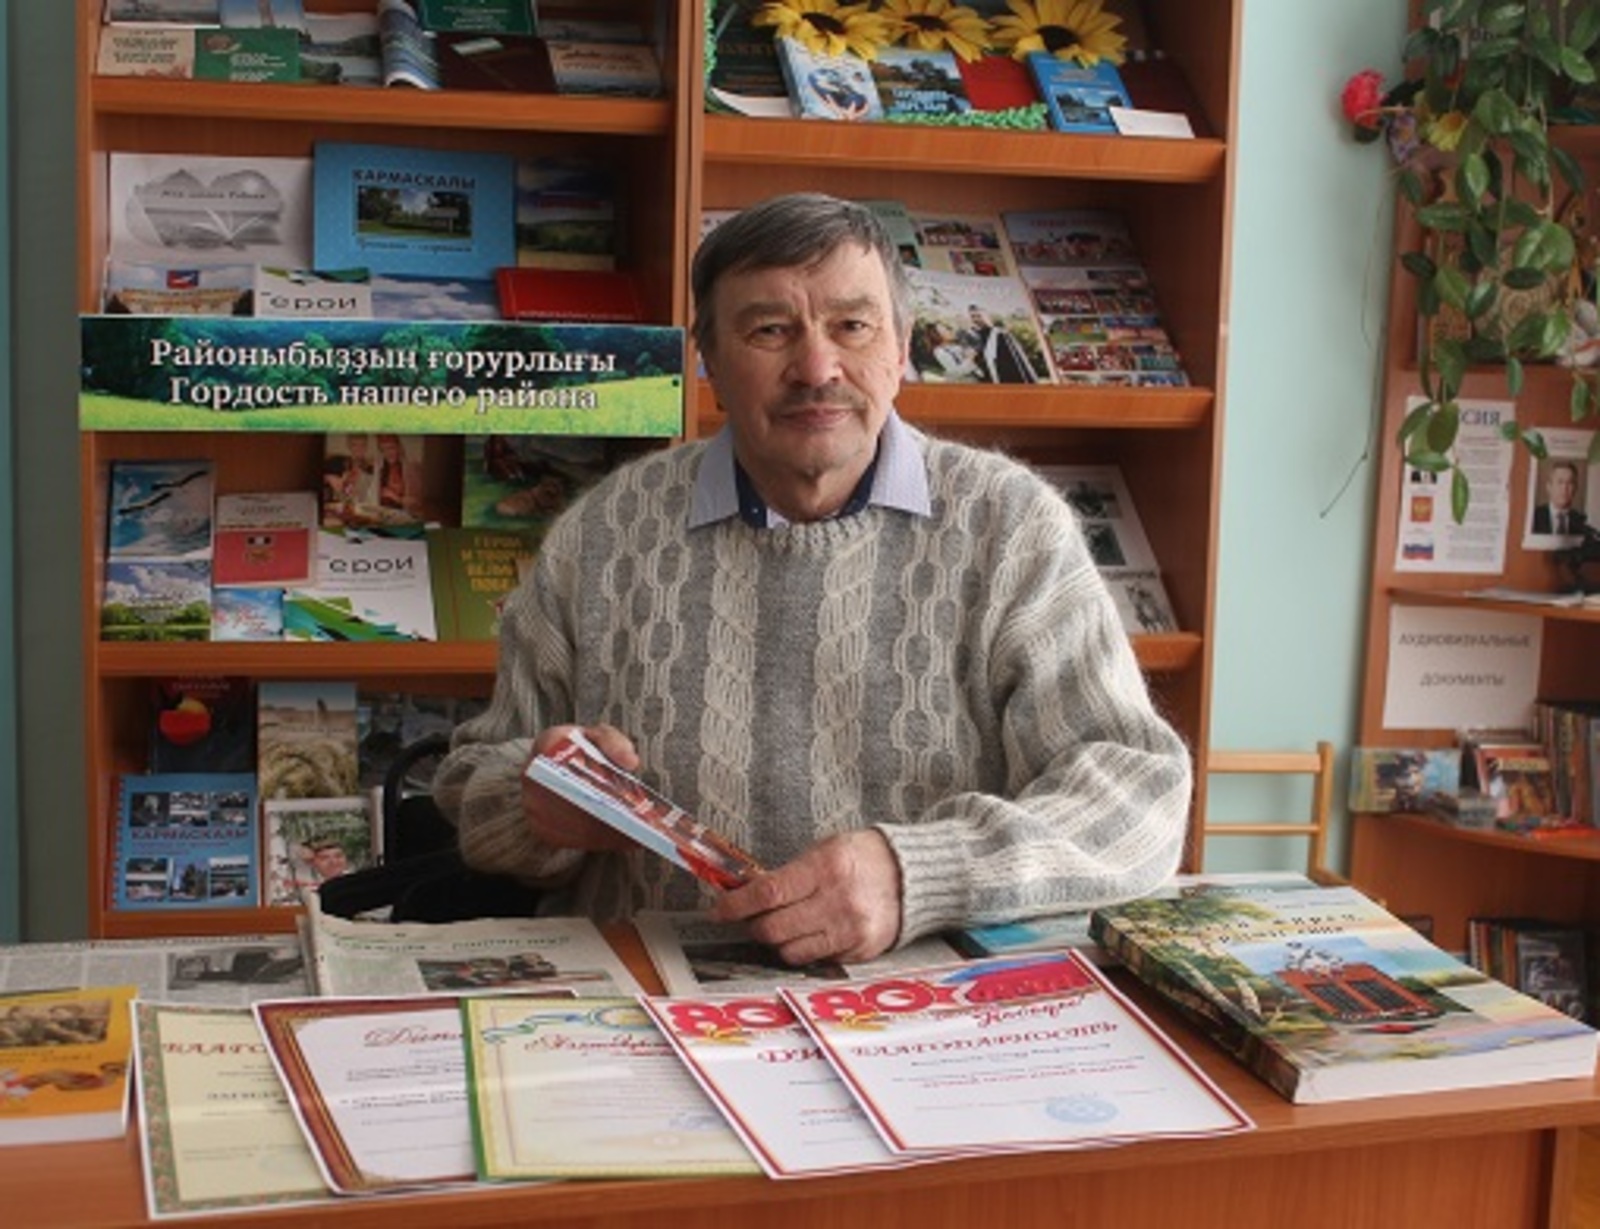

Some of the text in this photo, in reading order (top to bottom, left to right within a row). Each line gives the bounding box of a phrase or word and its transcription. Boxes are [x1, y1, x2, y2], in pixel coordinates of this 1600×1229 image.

[354, 169, 476, 190] КАРМАСКАЛЫ
[169, 376, 598, 413] Гордость нашего района
[1460, 408, 1501, 427] СИЯ
[1398, 632, 1532, 649] АУДИОВИЗУАЛЬНЫЕ
[1419, 672, 1506, 687] ДОКУМЕНТЫ
[807, 980, 937, 1022] 80
[850, 1020, 1119, 1059] БЛАГОДАРНОСТЬ
